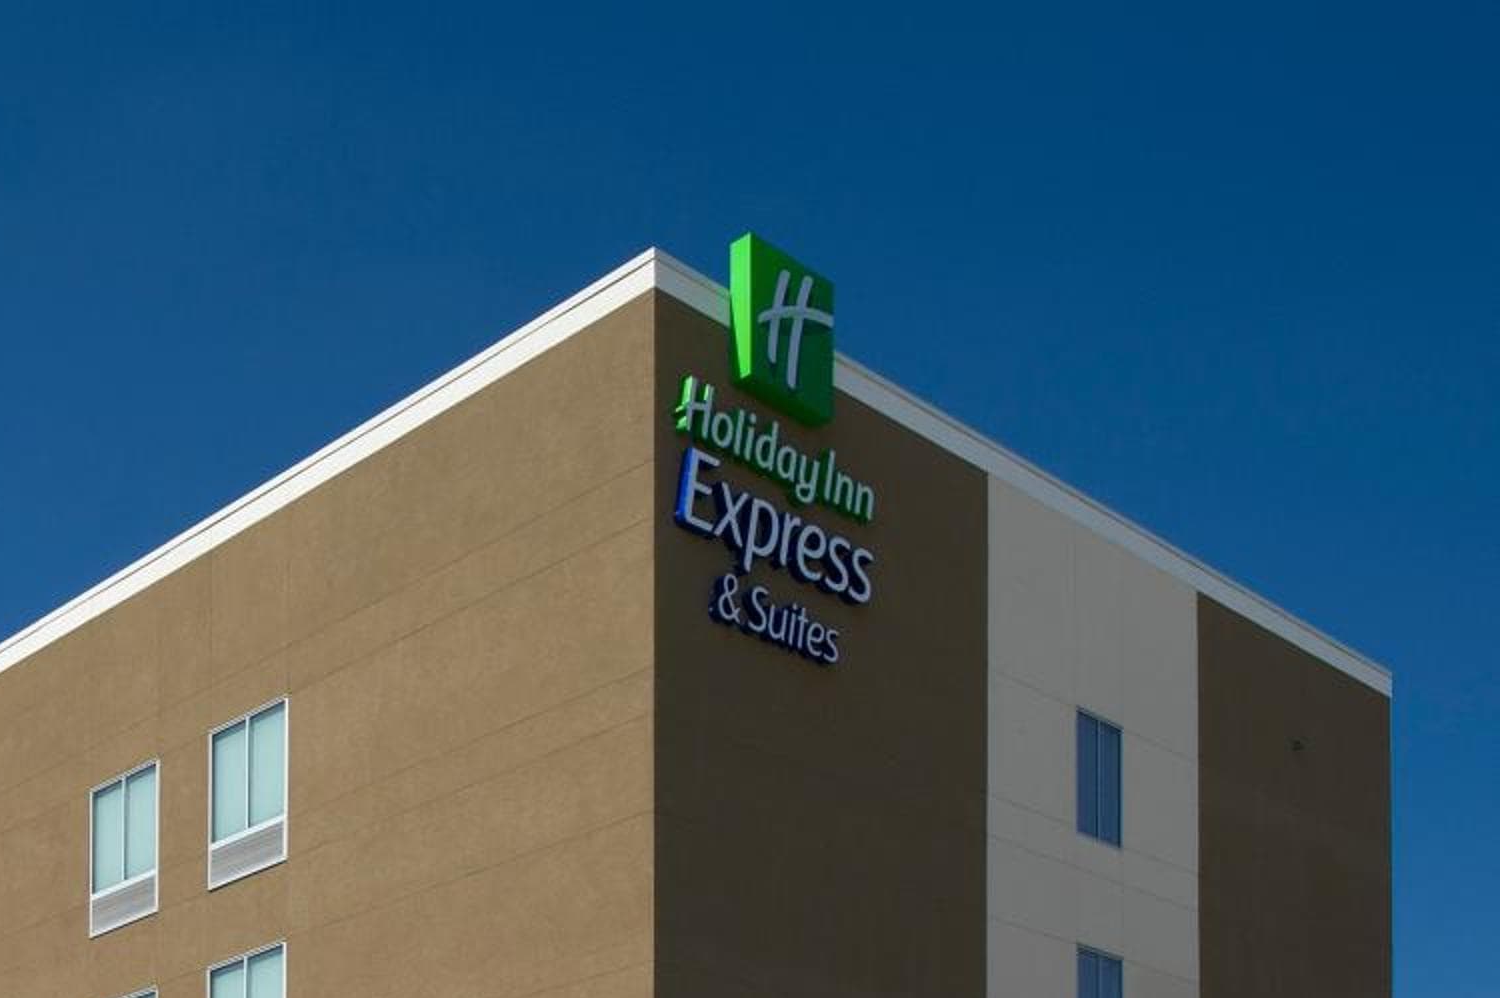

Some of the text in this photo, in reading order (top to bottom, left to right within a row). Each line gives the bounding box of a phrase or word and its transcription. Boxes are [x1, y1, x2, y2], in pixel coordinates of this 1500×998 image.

[757, 268, 835, 389] H
[677, 374, 876, 522] Holiday Inn
[680, 446, 875, 604] Express
[717, 572, 841, 664] & Suites
